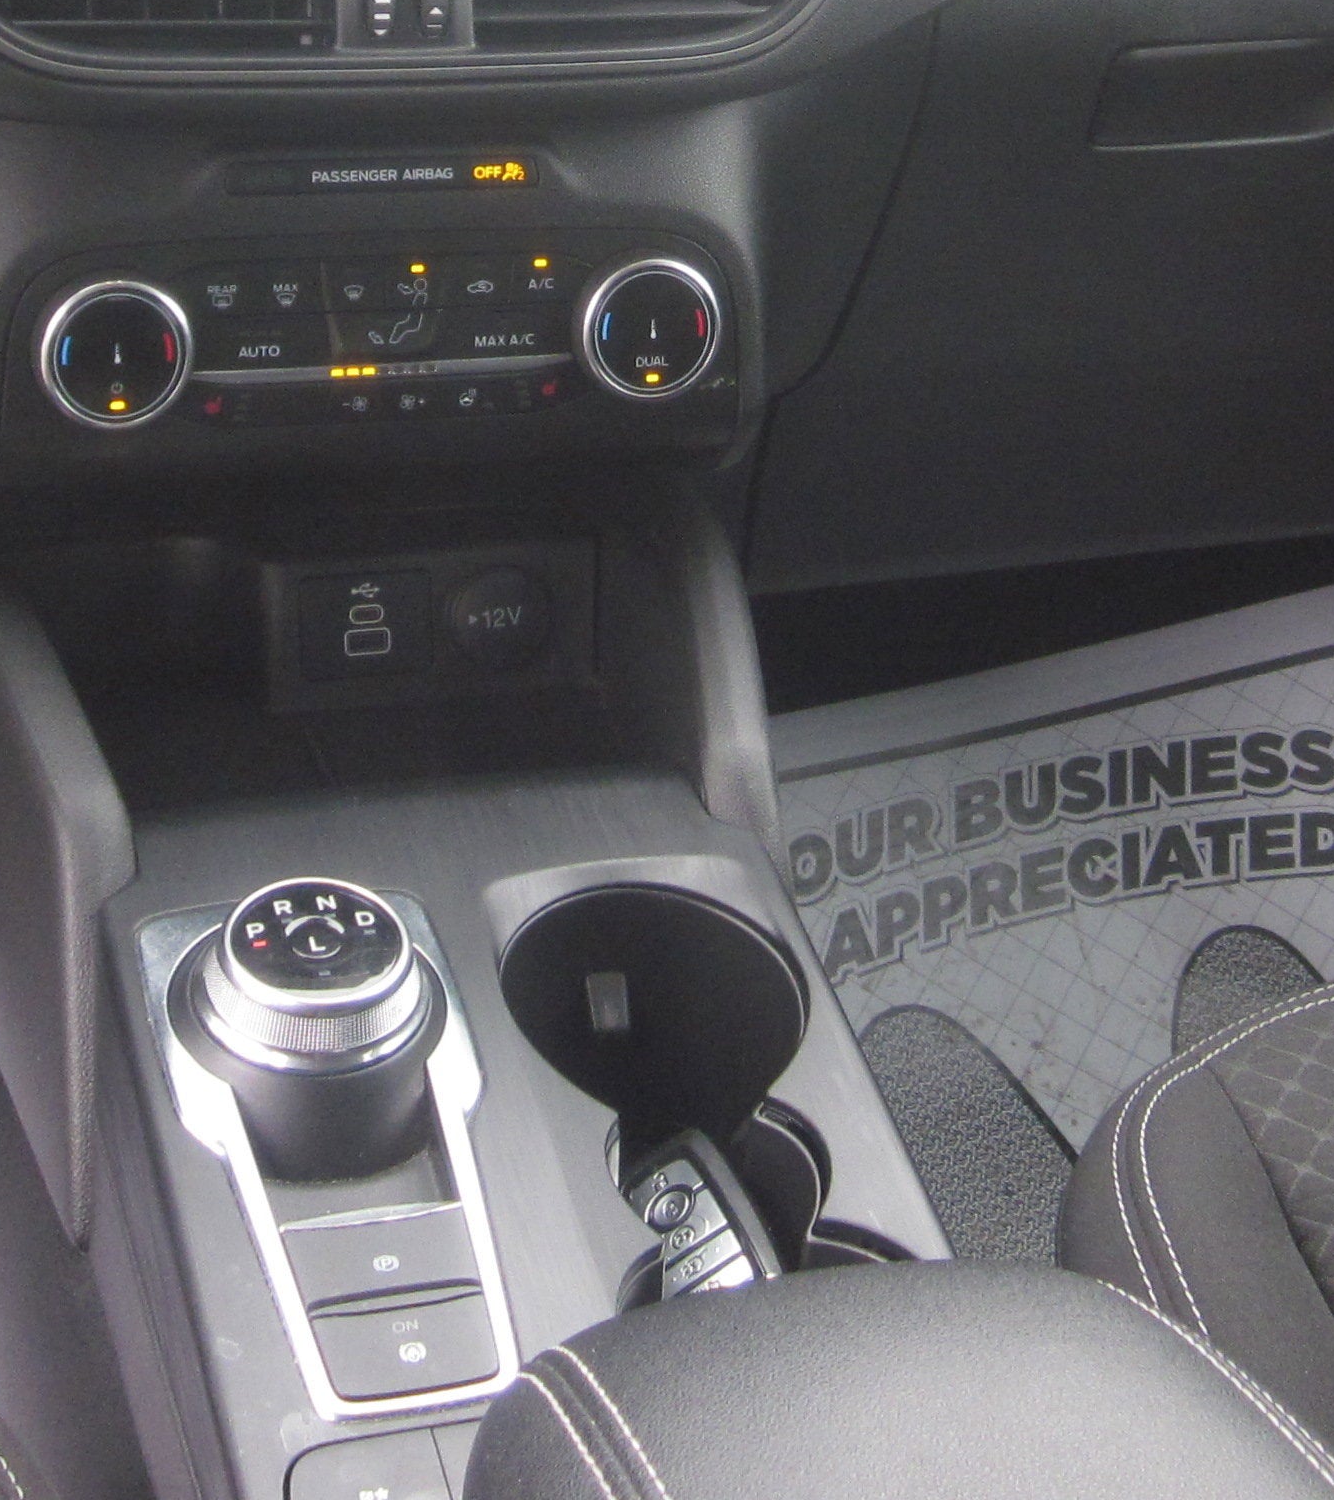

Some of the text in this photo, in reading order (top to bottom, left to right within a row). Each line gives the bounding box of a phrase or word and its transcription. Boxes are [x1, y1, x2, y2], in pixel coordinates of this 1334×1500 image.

[312, 169, 397, 183] PASSENGER
[402, 167, 454, 180] AIRBAG
[473, 165, 502, 179] OFF
[207, 284, 237, 294] REAR
[273, 283, 299, 293] MAX
[528, 278, 555, 290] A/C
[474, 333, 535, 348] MAX A/C
[239, 345, 280, 358] AUTO
[635, 356, 669, 368] DUAL
[482, 606, 521, 629] 12V
[245, 895, 375, 939] P R N D
[308, 936, 326, 952] L
